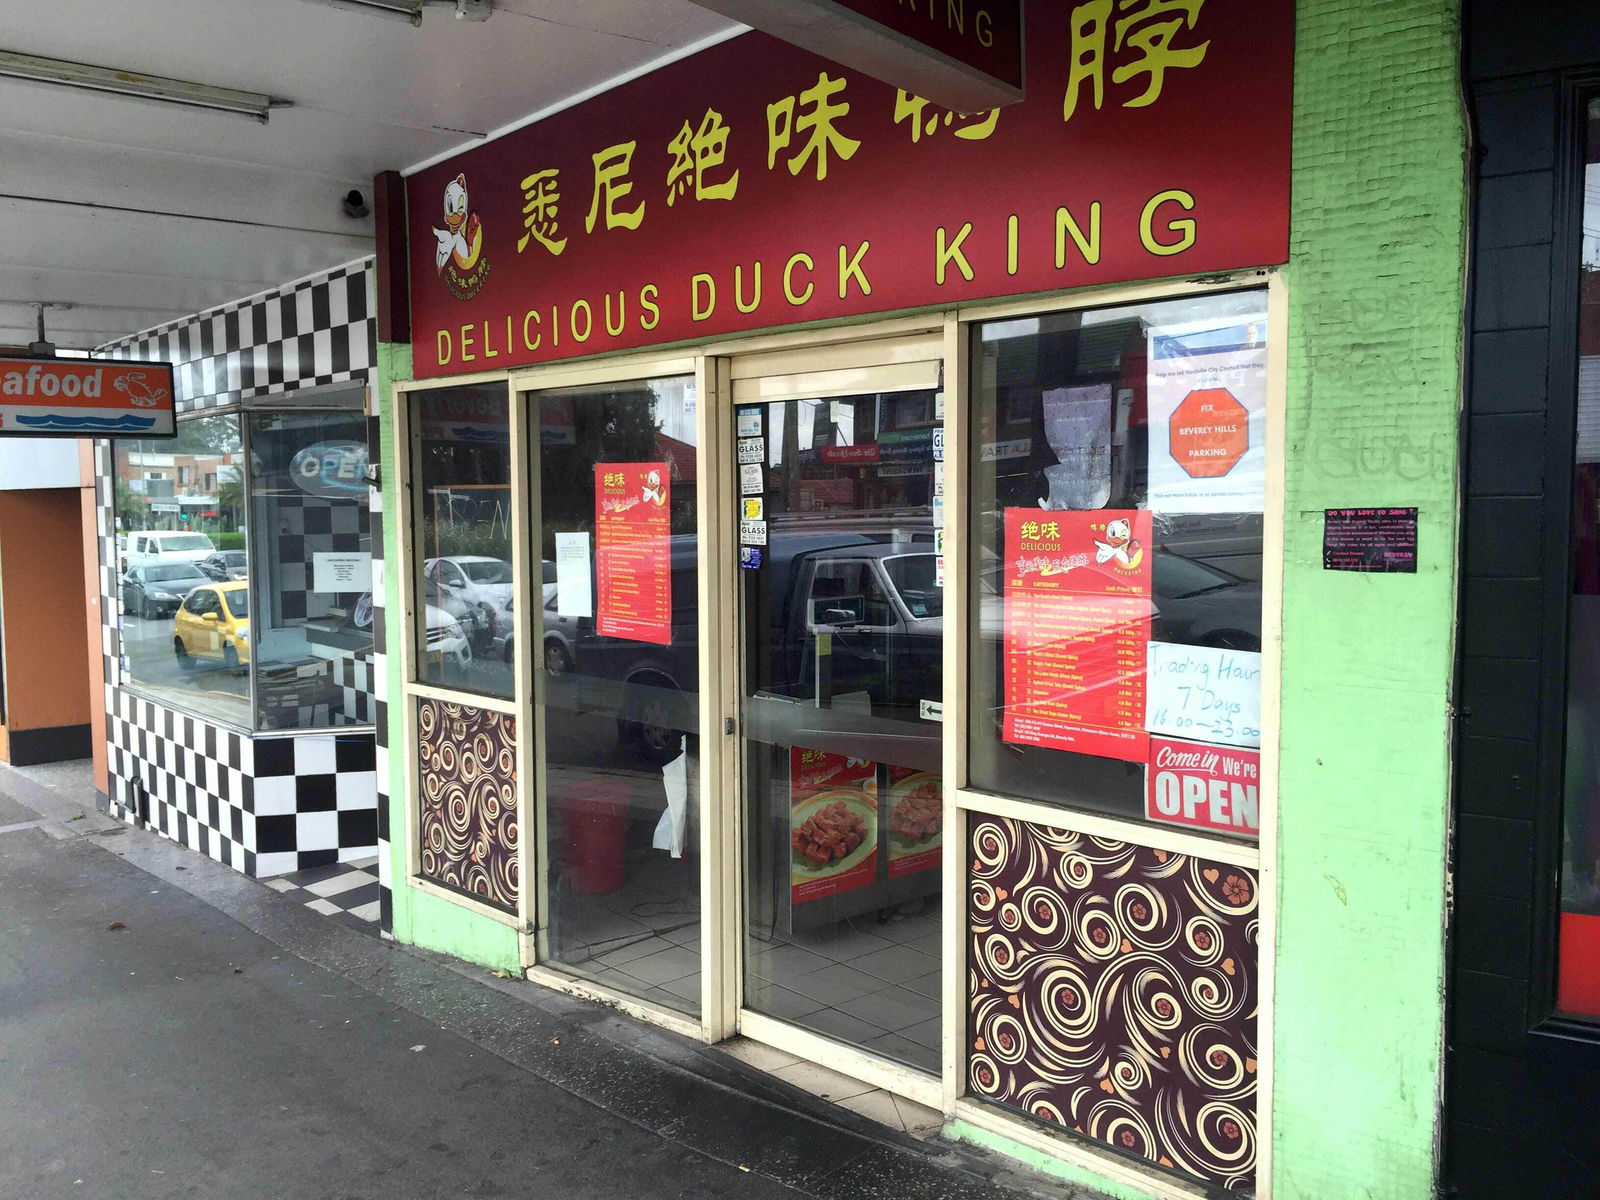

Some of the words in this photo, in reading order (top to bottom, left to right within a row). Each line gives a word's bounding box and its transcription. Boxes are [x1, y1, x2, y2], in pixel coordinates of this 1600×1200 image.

[898, 0, 993, 48] ING
[437, 284, 660, 366] DELICIOUS
[691, 240, 872, 323] DUCK
[934, 189, 1197, 286] KING
[1200, 404, 1214, 412] FIX
[1179, 425, 1212, 435] BEVERLY
[1214, 424, 1237, 433] HILLS
[739, 444, 763, 453] GLASS
[1188, 448, 1227, 457] PARKING
[741, 526, 766, 535] GLASS
[1021, 521, 1061, 541] 绝味
[1021, 543, 1061, 552] DELICIOUS
[1178, 686, 1191, 710] 7
[1201, 689, 1241, 718] Days
[1156, 746, 1199, 768] Come
[1200, 750, 1220, 771] in
[1222, 756, 1257, 779] We're
[1155, 771, 1259, 830] OPEN
